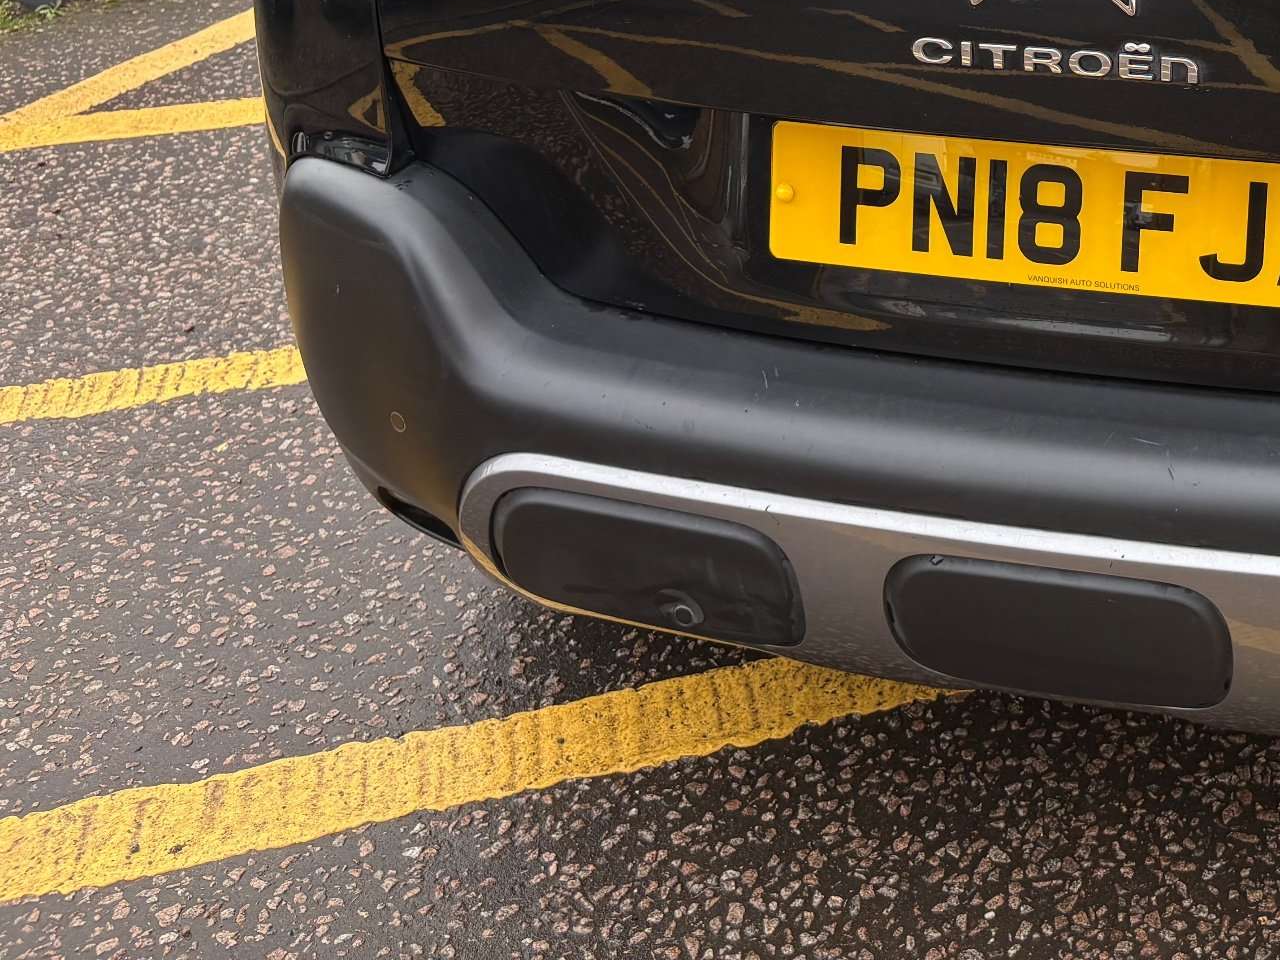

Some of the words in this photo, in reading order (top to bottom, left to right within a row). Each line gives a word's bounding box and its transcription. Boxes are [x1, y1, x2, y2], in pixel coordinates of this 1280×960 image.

[839, 145, 1083, 267] PN18
[1027, 274, 1068, 285] VANQUISH
[1070, 279, 1093, 287] AUTO
[1094, 280, 1140, 292] SOLUTIONS
